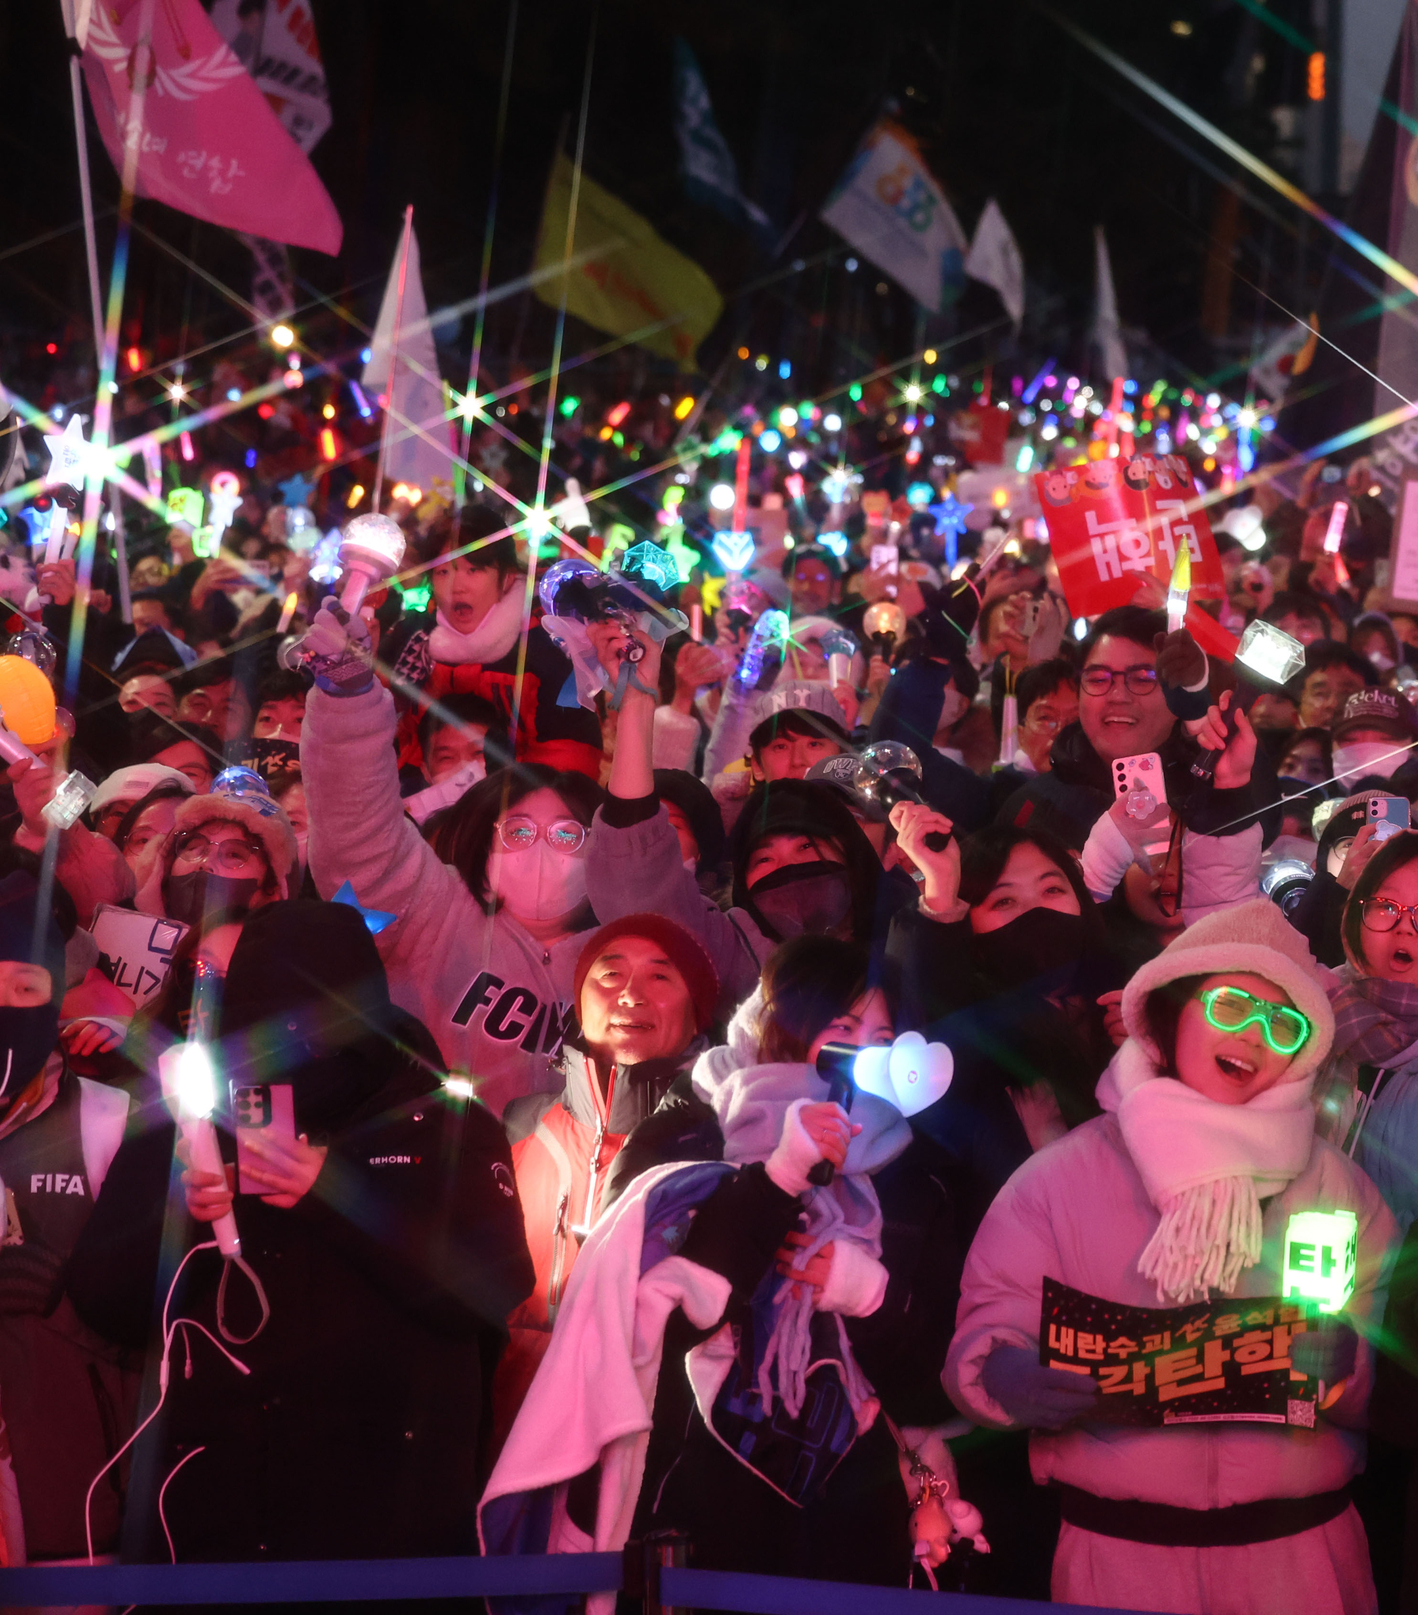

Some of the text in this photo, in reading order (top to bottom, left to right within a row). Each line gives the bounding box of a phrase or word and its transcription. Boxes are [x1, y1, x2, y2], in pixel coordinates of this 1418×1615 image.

[30, 1173, 85, 1196] FIFA
[1288, 1240, 1337, 1306] 탄
[1049, 1323, 1172, 1361] 내란수괴
[1154, 1320, 1309, 1403] 탄핵
